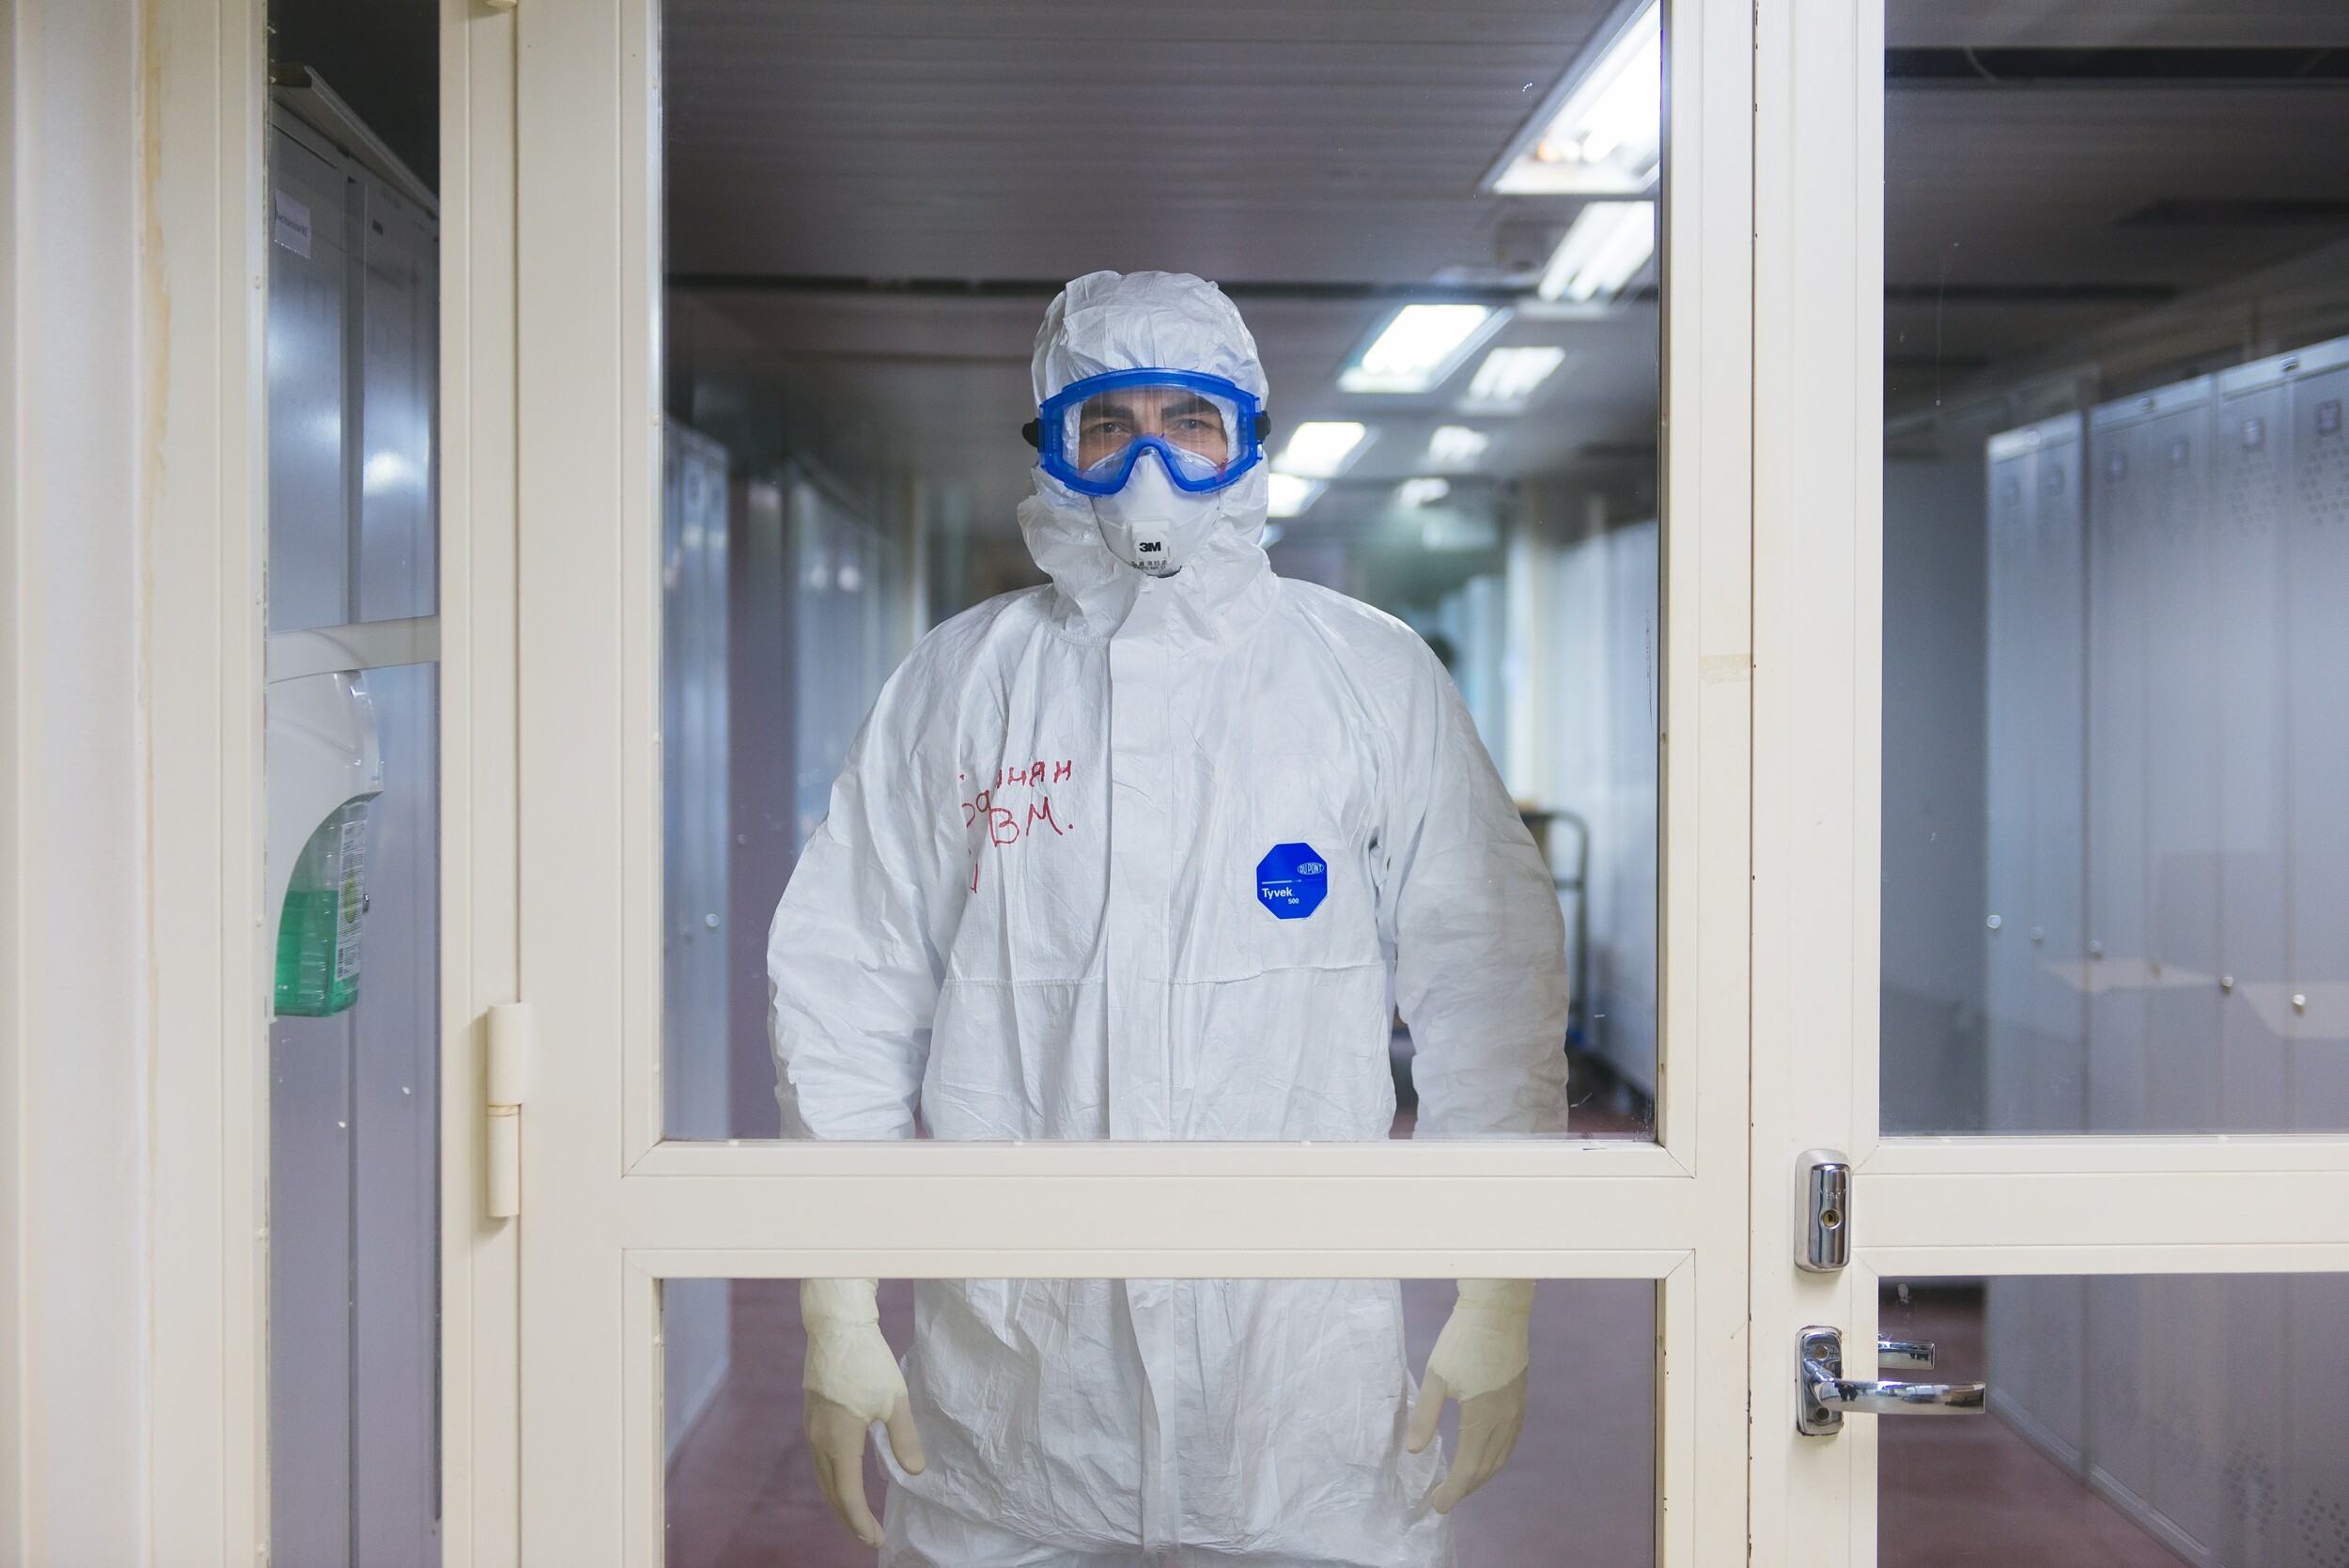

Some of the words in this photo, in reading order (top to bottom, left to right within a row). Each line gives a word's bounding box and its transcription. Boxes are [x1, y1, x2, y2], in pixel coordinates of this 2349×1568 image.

[1139, 541, 1161, 552] 3M
[1299, 862, 1324, 875] DUPONT
[1262, 887, 1293, 900] Tyvek
